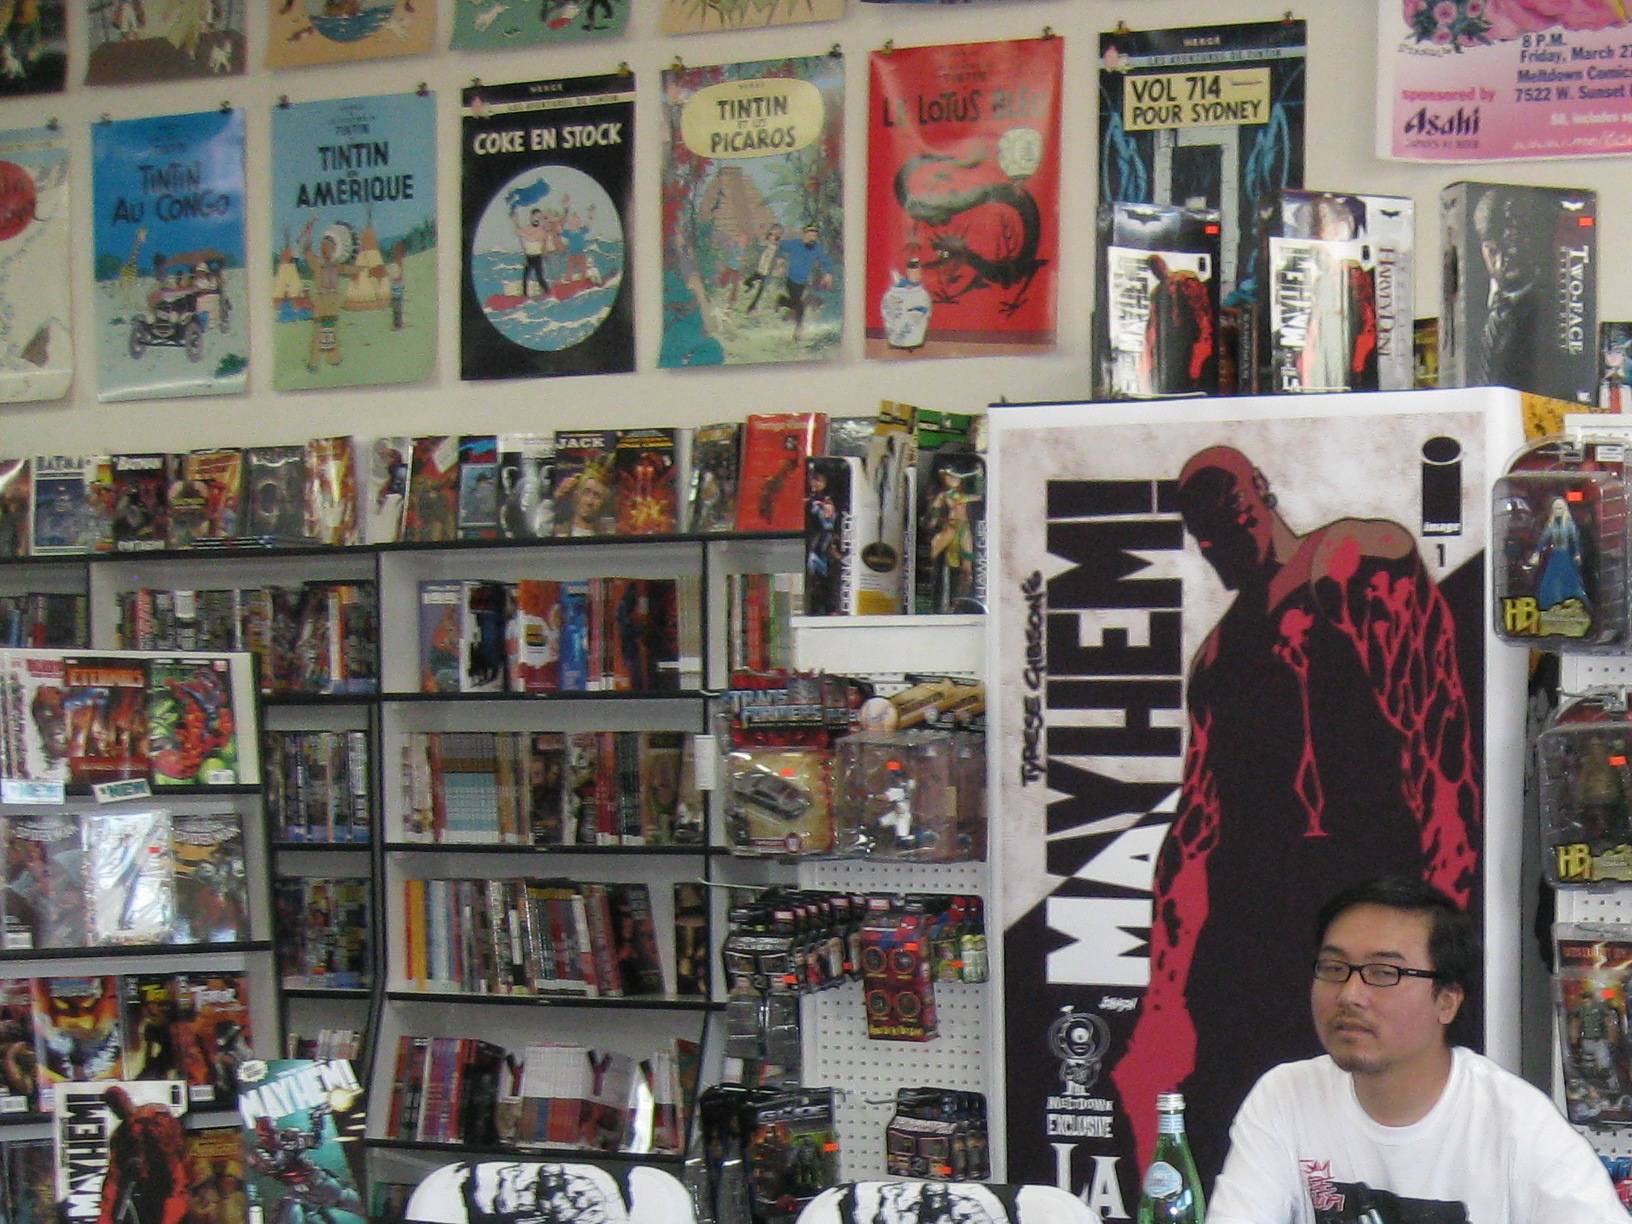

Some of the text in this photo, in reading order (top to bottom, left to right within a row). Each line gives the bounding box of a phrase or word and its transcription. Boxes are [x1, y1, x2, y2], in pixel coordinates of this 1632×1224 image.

[1522, 33, 1568, 48] 8 P.M.
[1519, 48, 1567, 64] Friday,
[1571, 46, 1615, 60] March
[1131, 75, 1222, 103] VOL 714
[1517, 69, 1583, 84] Meltdown
[1479, 88, 1496, 103] by
[1515, 87, 1552, 102] 7522
[1578, 84, 1625, 99] Sunset
[716, 95, 789, 122] TINTIN
[917, 89, 983, 126] LOTUS
[1132, 100, 1263, 126] POUR SYDNEY
[1404, 106, 1481, 136] Asahi
[473, 121, 624, 156] COKE EN STOCK
[710, 126, 797, 154] PICAROS
[317, 140, 390, 171] TINTIN
[110, 187, 231, 226] AU CONGO
[556, 437, 605, 450] JACK
[1021, 702, 1047, 788] TYRESE
[1046, 1113, 1114, 1138] EXCLUSIVE
